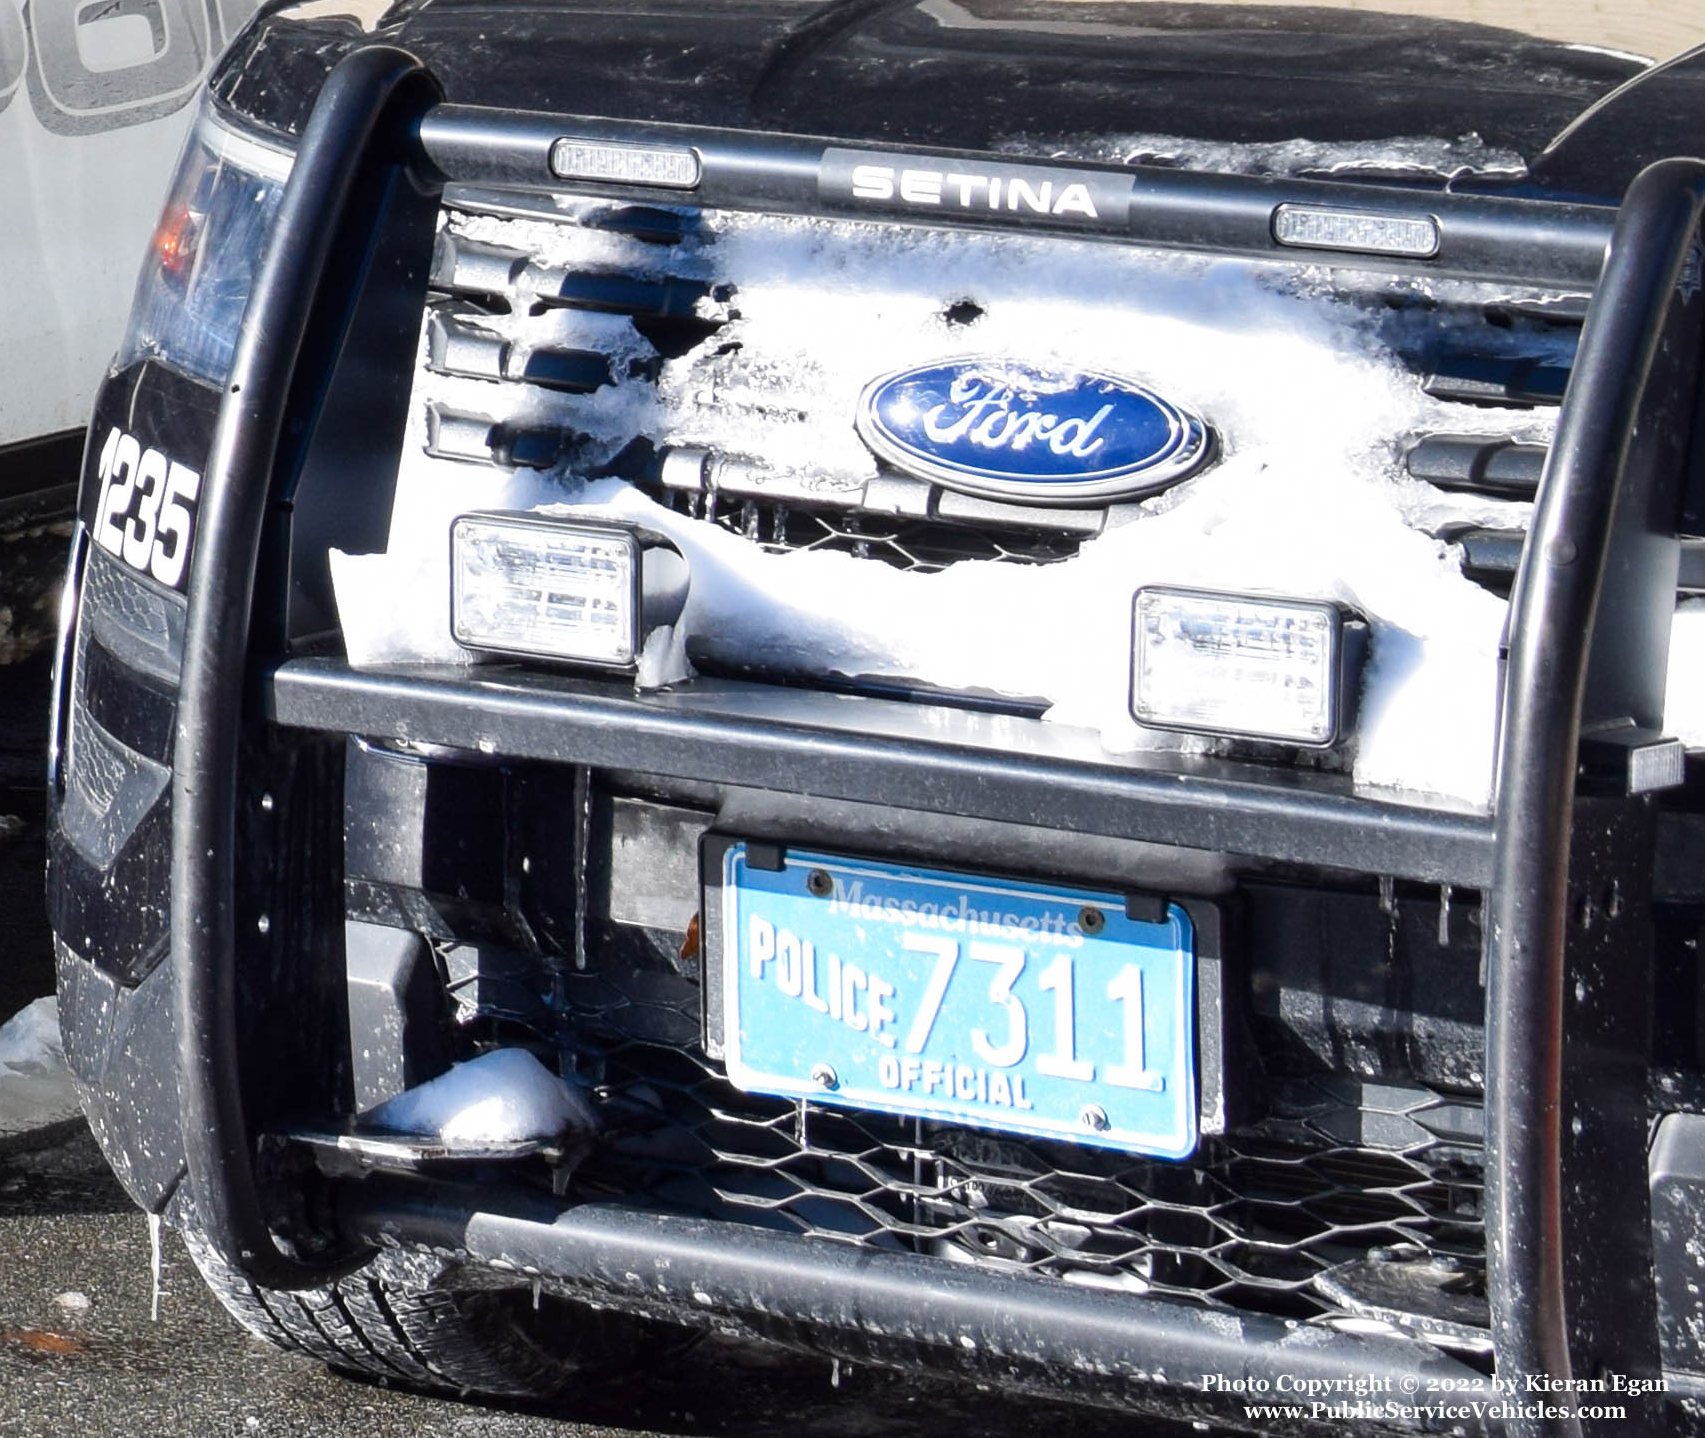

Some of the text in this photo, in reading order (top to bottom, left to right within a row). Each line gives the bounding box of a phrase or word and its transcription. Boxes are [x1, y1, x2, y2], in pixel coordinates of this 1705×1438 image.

[852, 164, 1099, 218] SETINA
[923, 369, 1117, 458] Ford
[92, 426, 201, 587] 1235
[828, 877, 1087, 949] Massachusetts
[749, 913, 1167, 1093] POLICE 7311
[879, 1057, 1035, 1111] OFFICIAL
